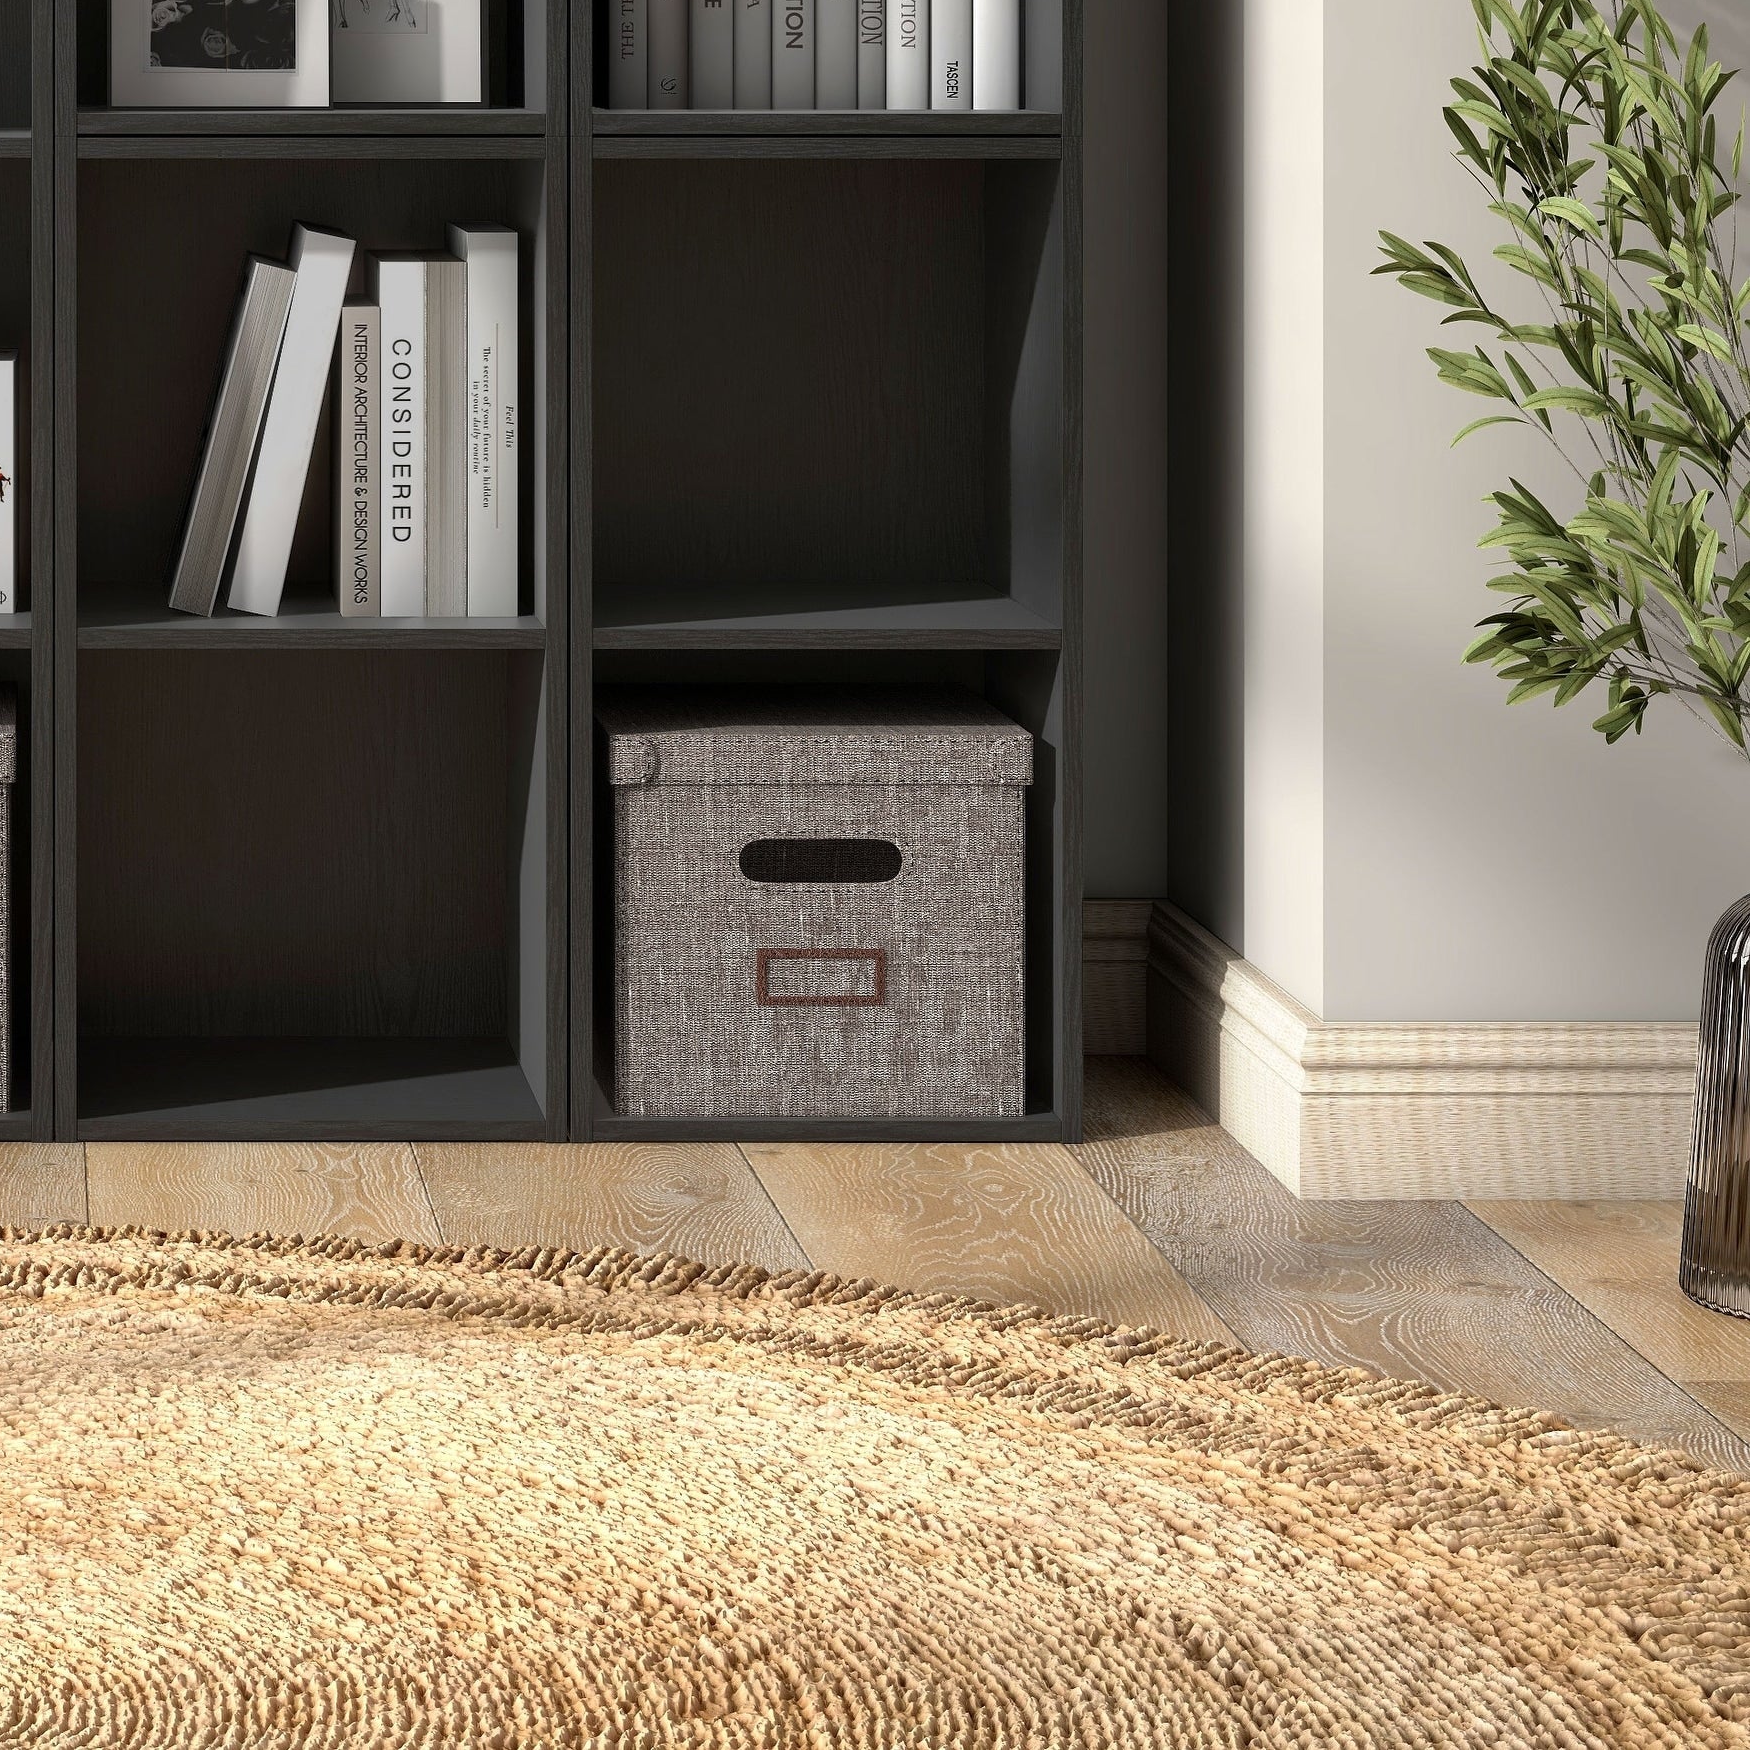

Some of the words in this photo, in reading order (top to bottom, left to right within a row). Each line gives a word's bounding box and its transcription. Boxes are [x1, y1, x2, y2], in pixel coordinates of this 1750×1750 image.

[621, 22, 634, 60] THE
[946, 61, 958, 99] TASCEN
[354, 324, 367, 384] INTERIOR
[483, 347, 491, 362] The
[472, 381, 481, 390] in
[483, 366, 491, 393] secret
[471, 393, 480, 415] your
[482, 396, 491, 407] of
[471, 417, 481, 440] daily
[481, 409, 490, 430] your
[505, 406, 514, 425] Feel
[354, 387, 367, 483] ARCHITECTURE
[392, 339, 412, 543] CONSIDERED
[483, 433, 491, 462] future
[505, 429, 514, 449] This
[472, 443, 481, 475] routine
[483, 465, 491, 474] is
[354, 487, 367, 497] &
[483, 476, 491, 508] hidden
[354, 501, 367, 553] DESIGN
[354, 555, 367, 604] WORKS
